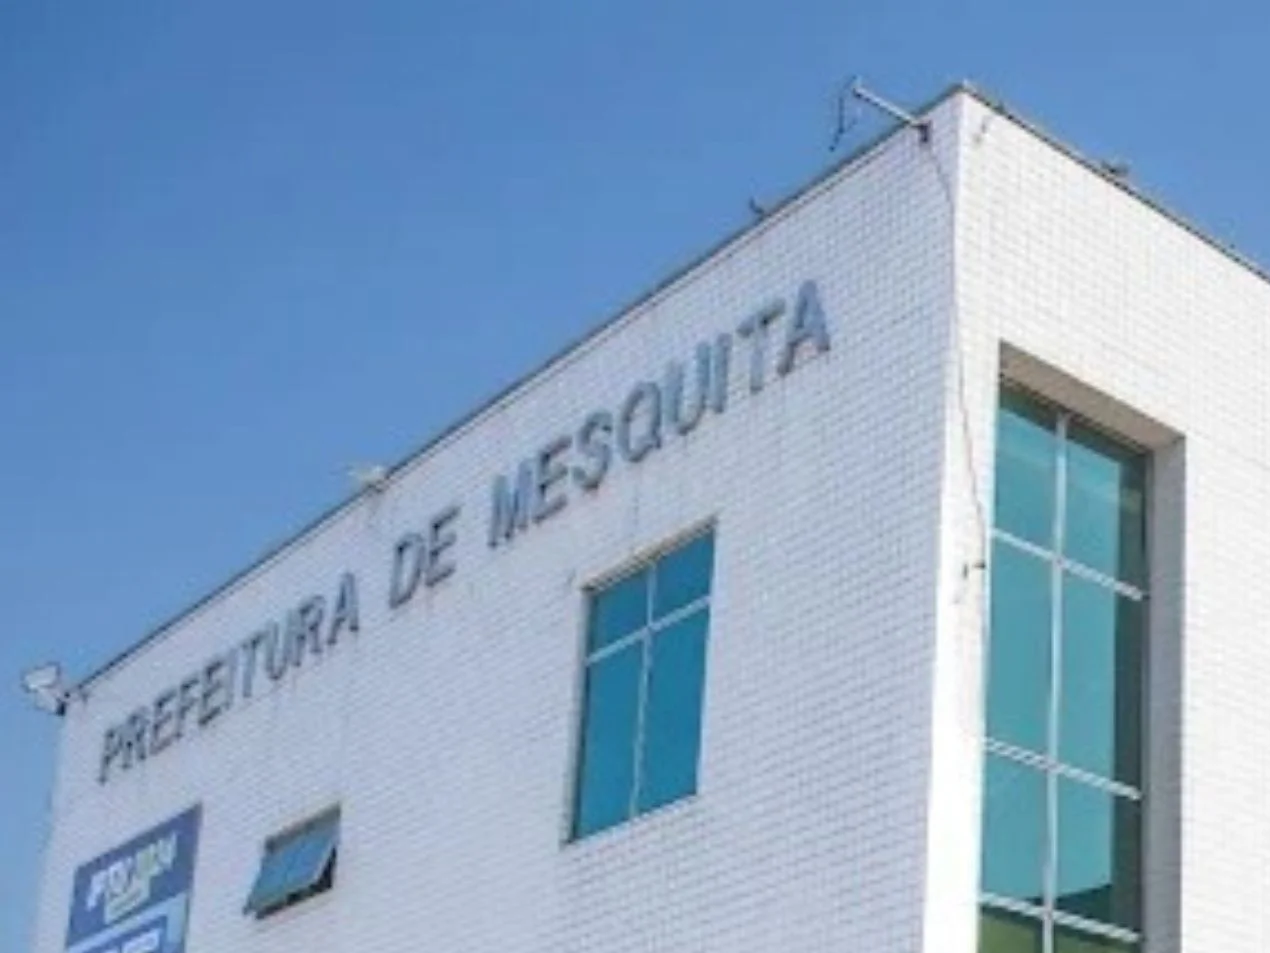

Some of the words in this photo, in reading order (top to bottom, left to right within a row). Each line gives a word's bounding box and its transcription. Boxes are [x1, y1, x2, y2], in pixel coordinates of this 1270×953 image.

[99, 572, 359, 783] PREFEITURA
[389, 506, 461, 609] DE
[487, 280, 831, 548] MESQUITA
